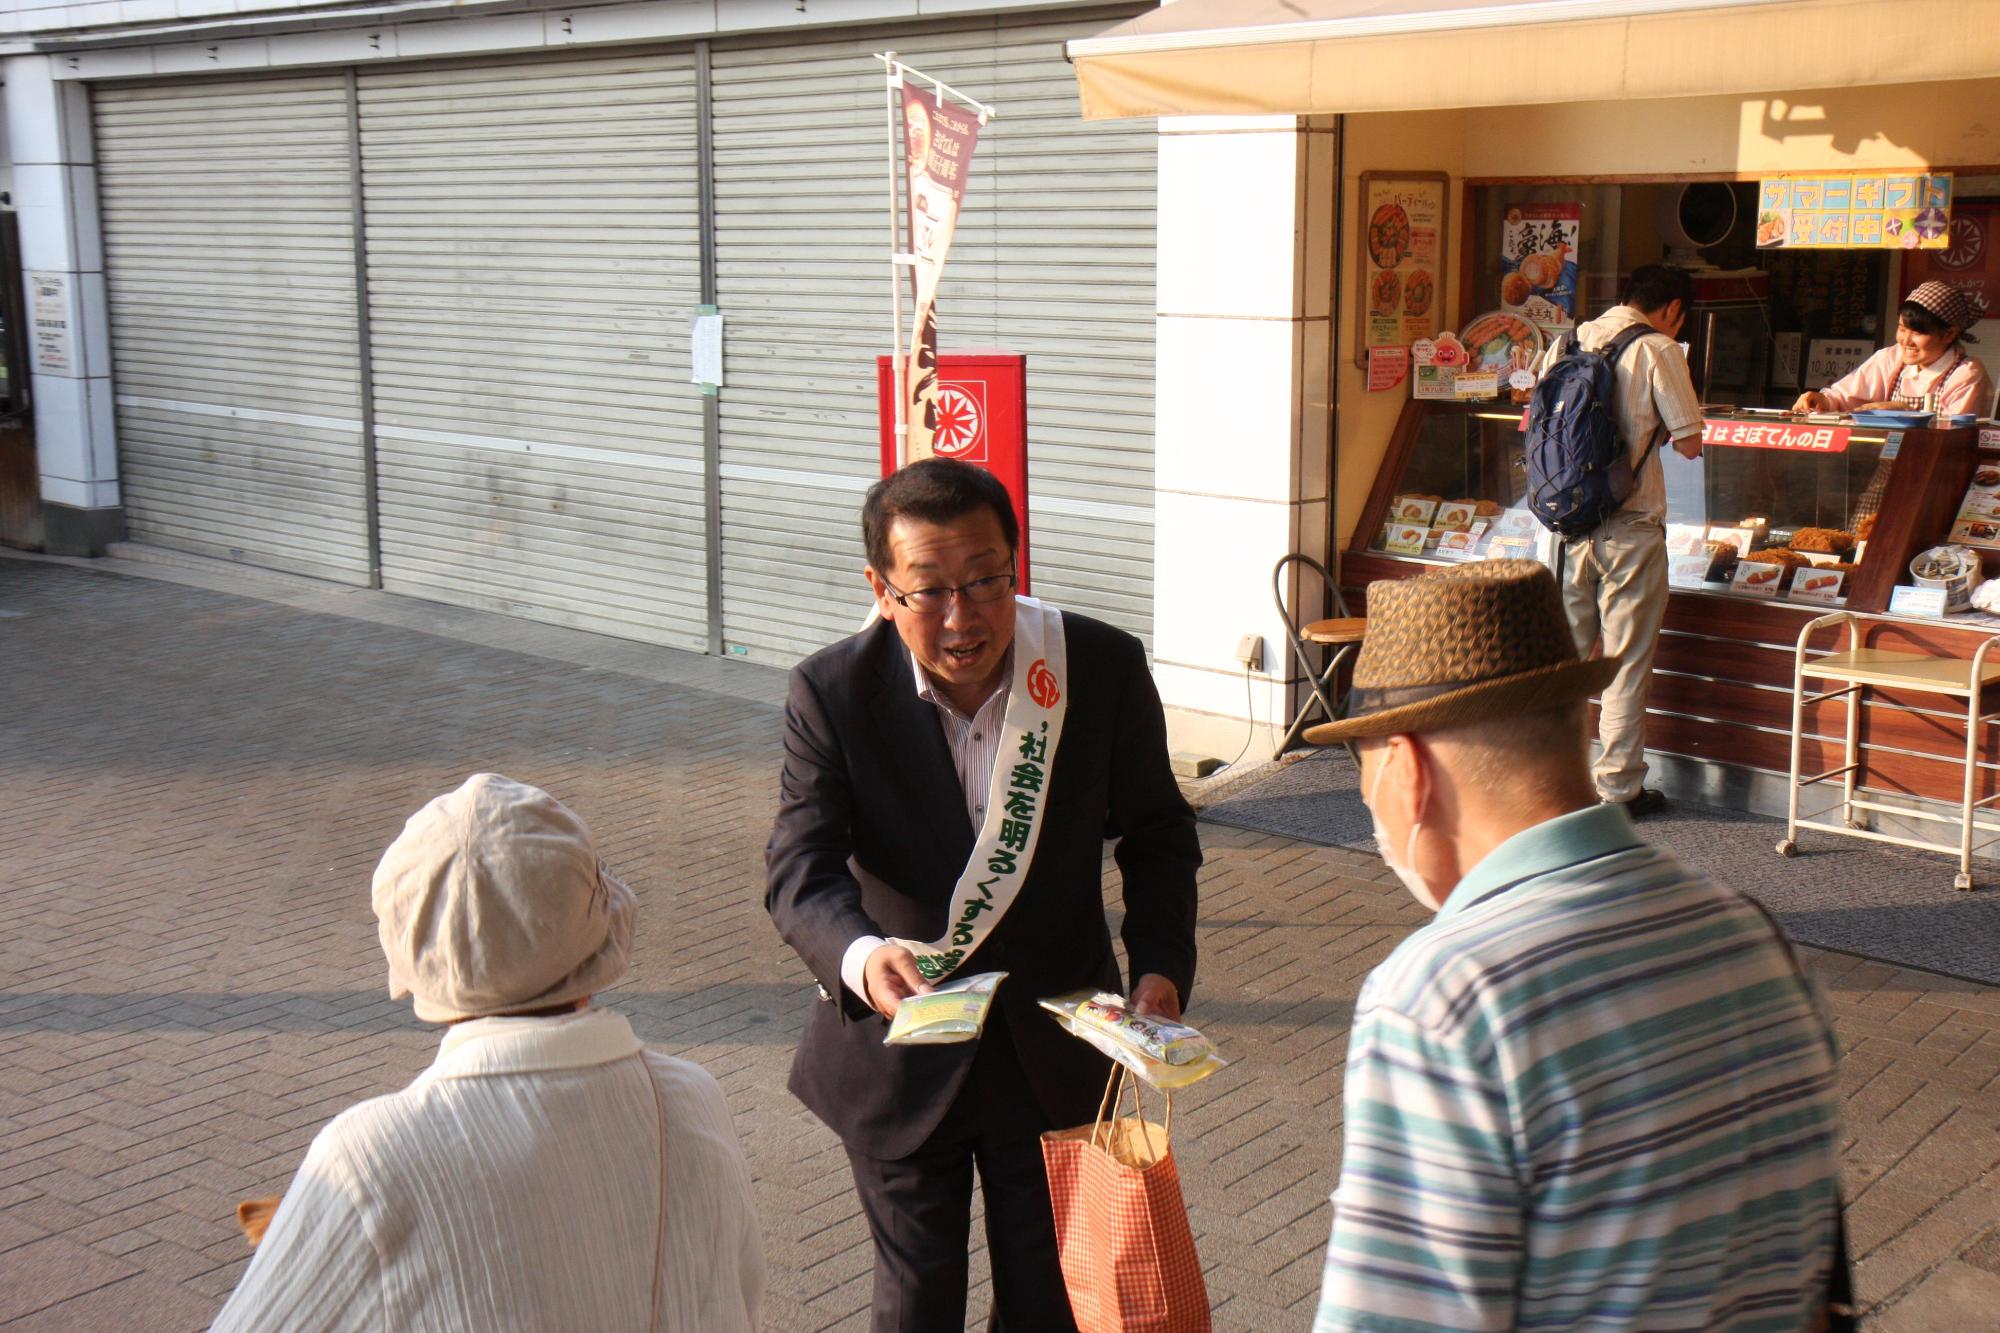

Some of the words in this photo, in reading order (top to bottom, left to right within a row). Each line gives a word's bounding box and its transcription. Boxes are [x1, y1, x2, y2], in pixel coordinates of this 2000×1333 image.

[1765, 178, 1944, 209] サマーギフト
[1792, 214, 1882, 244] 受付中
